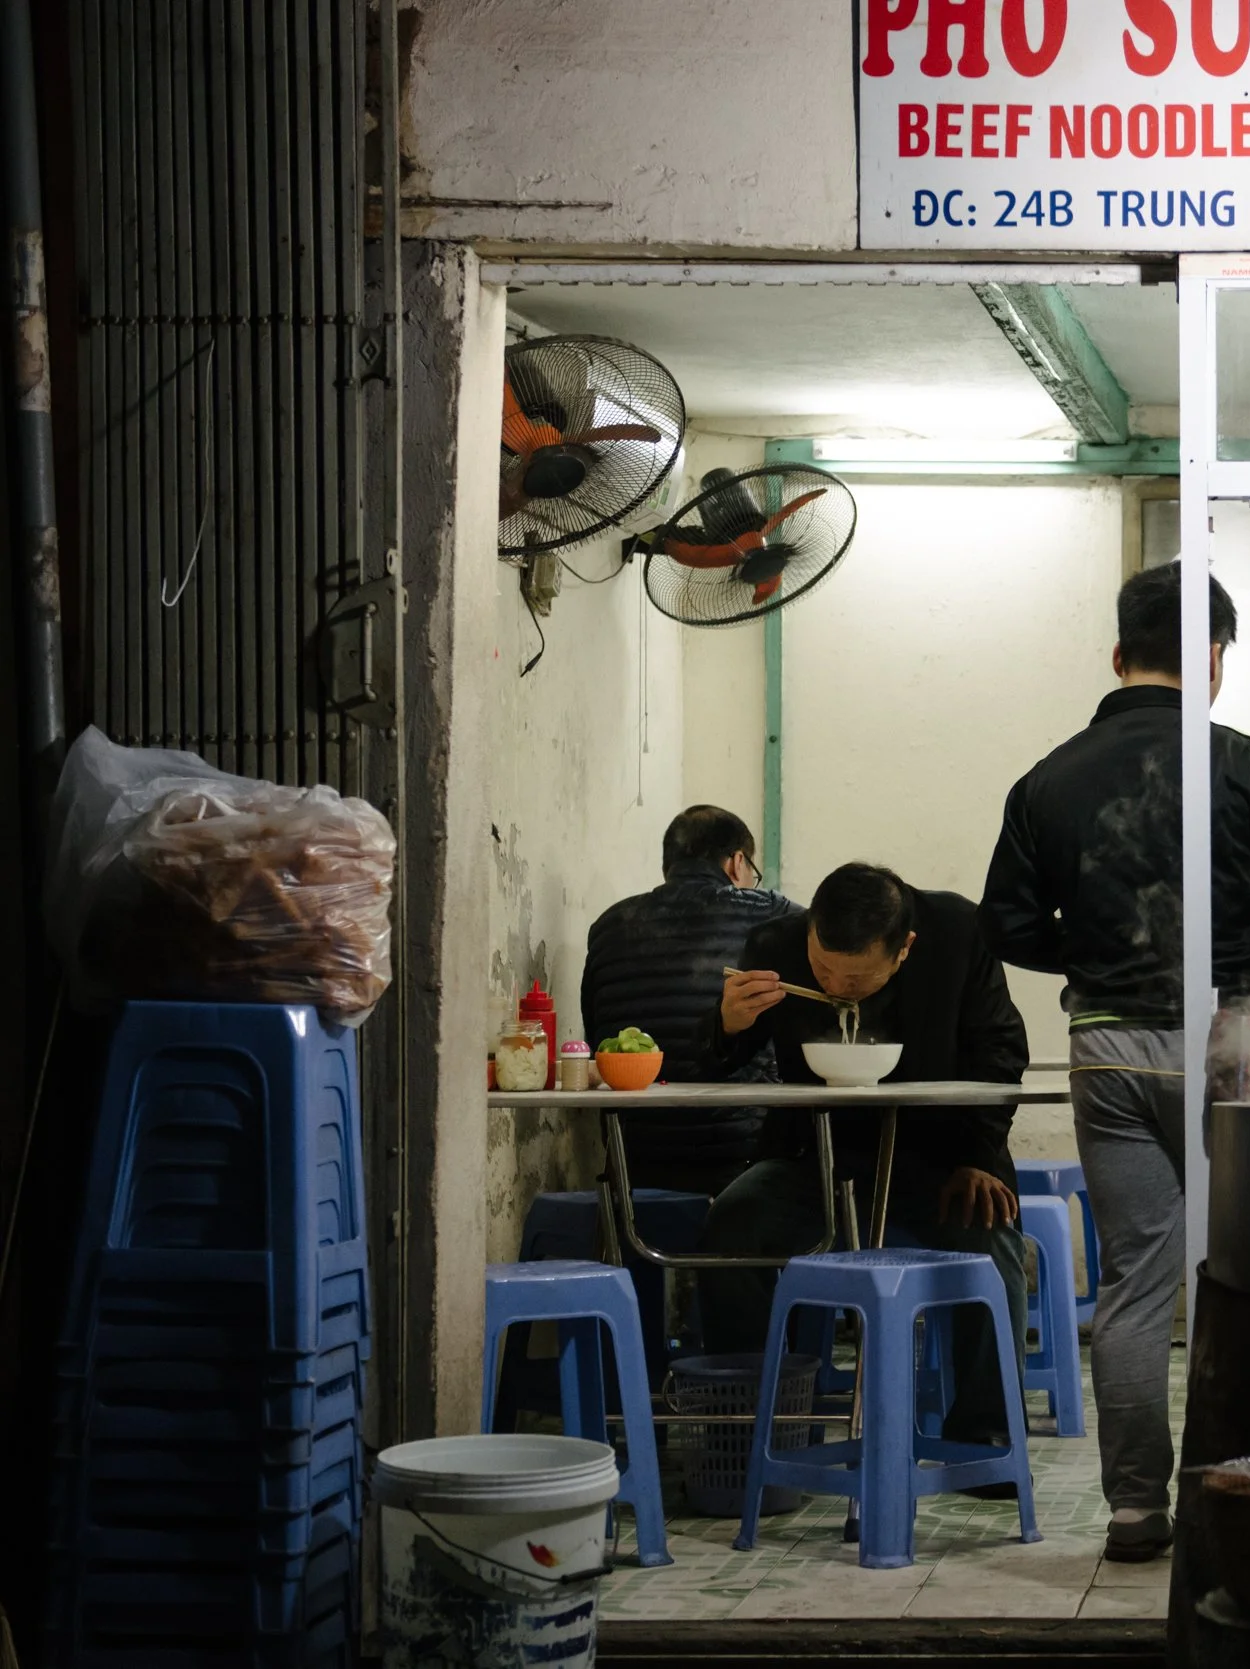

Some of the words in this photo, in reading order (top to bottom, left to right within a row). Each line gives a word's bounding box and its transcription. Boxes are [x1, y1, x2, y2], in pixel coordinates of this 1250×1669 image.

[899, 104, 1032, 158] BEEF
[912, 190, 977, 227] ĐC:
[994, 190, 1073, 227] 24B
[1097, 190, 1235, 227] TRUNG
